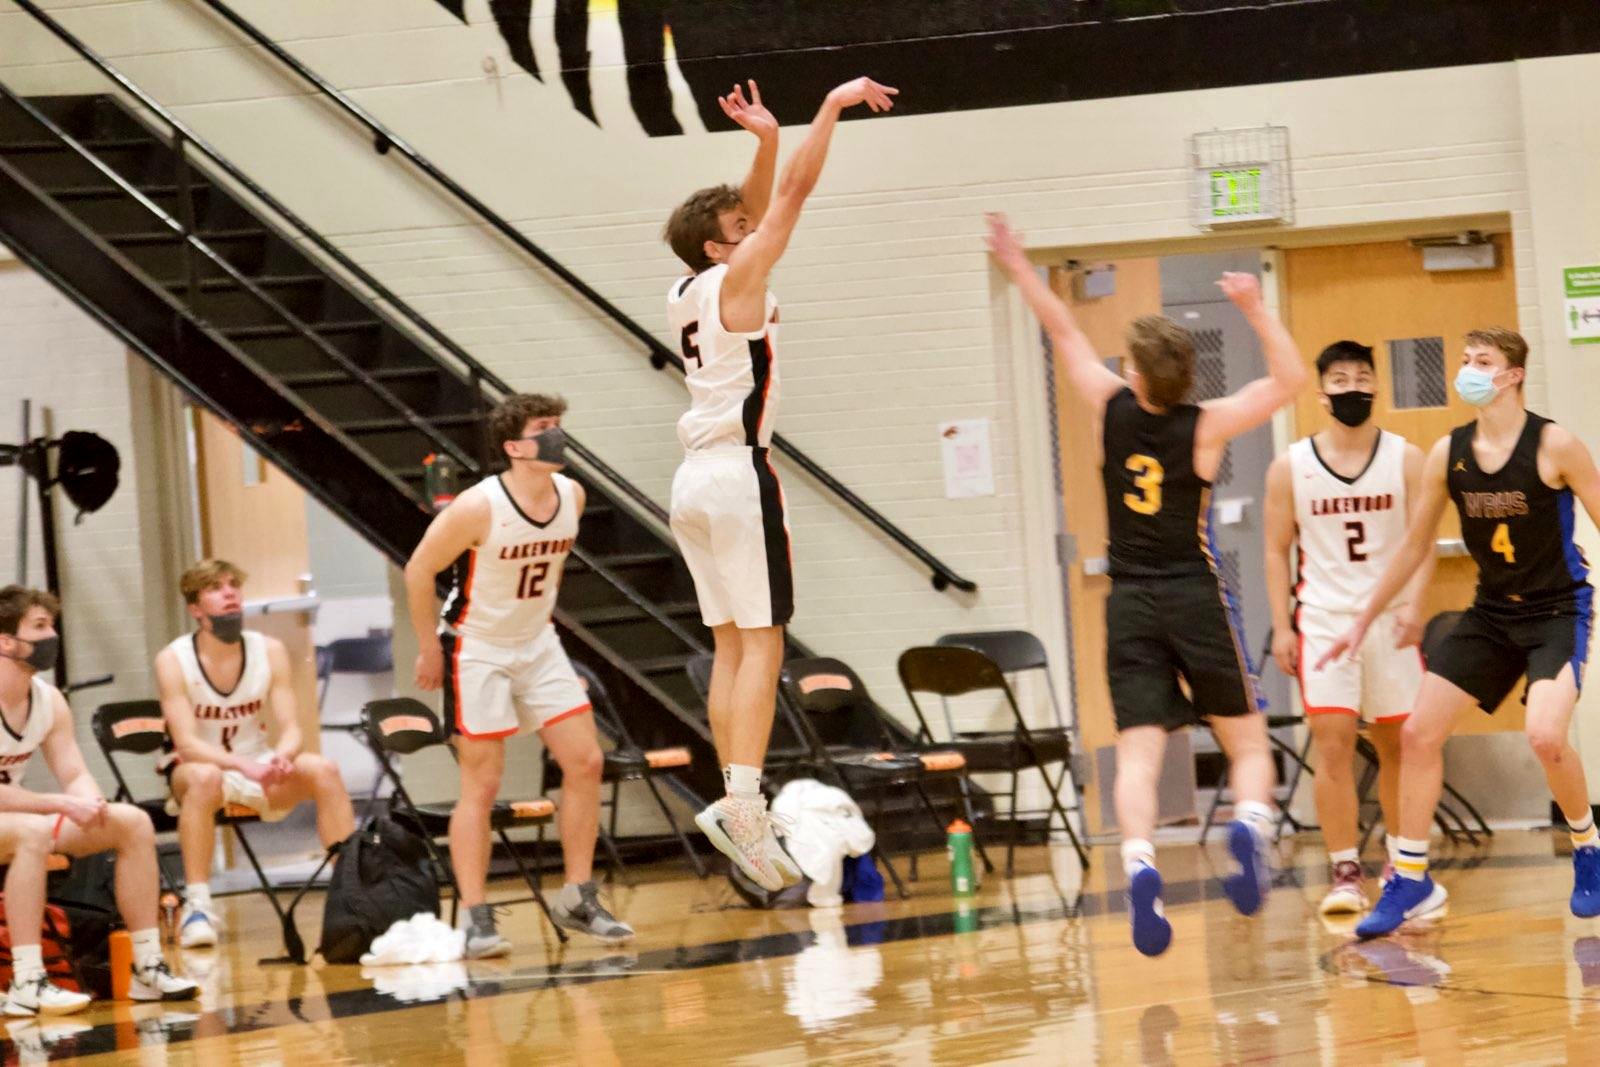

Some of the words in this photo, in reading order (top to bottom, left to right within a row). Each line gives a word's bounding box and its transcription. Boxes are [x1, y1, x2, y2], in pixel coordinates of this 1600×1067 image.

[1209, 168, 1262, 216] EXIT
[1123, 453, 1165, 515] 3
[1311, 494, 1393, 516] LAKEWOOD
[1344, 521, 1367, 562] 2
[1491, 523, 1516, 564] 4
[517, 562, 550, 600] 12
